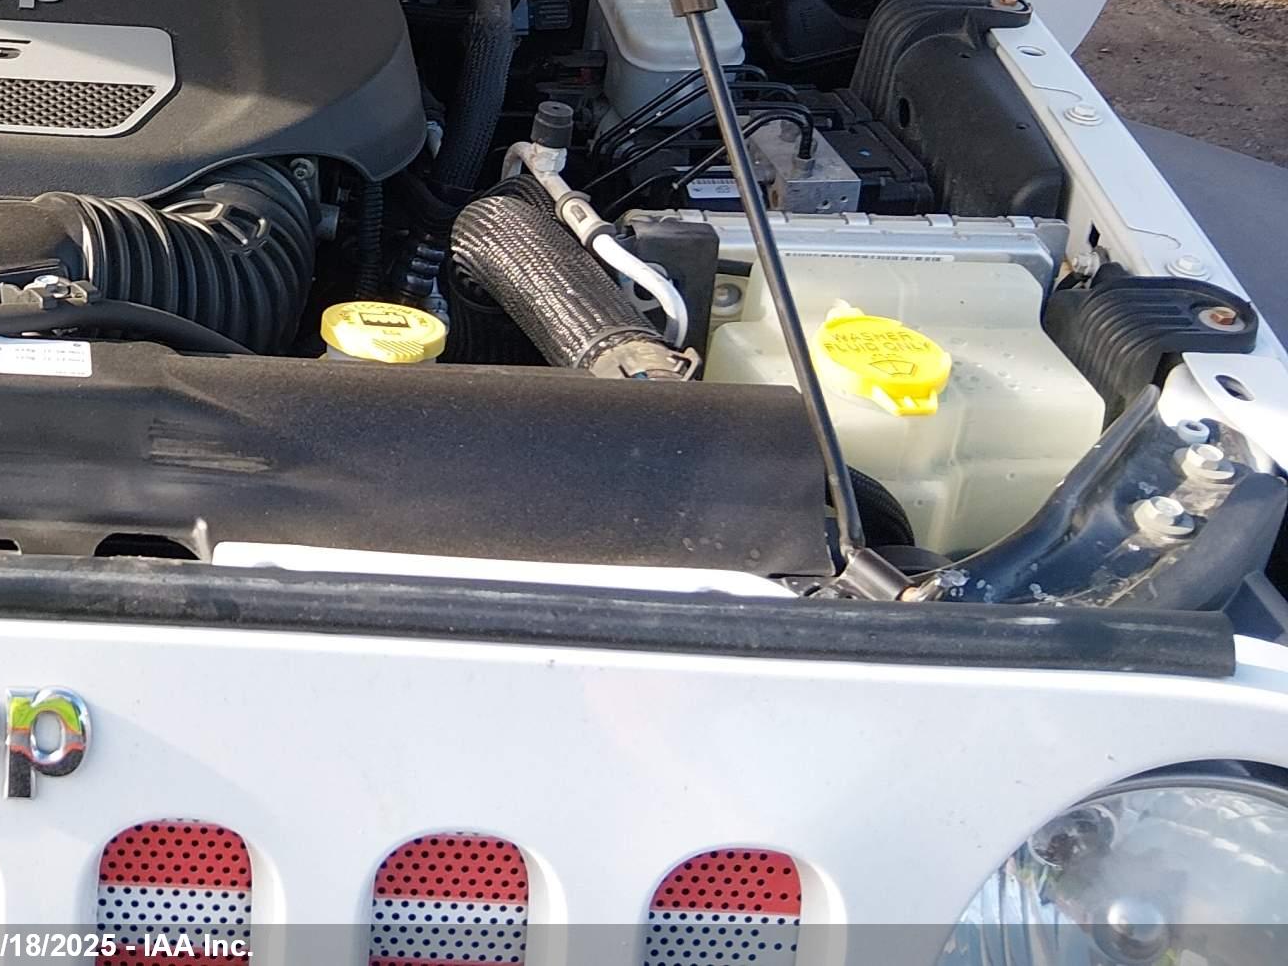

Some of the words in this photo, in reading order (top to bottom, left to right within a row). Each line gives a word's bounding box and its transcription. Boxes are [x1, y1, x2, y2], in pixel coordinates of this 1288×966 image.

[833, 331, 912, 342] WASHER
[823, 342, 879, 353] FLUID
[884, 341, 931, 352] ONLY
